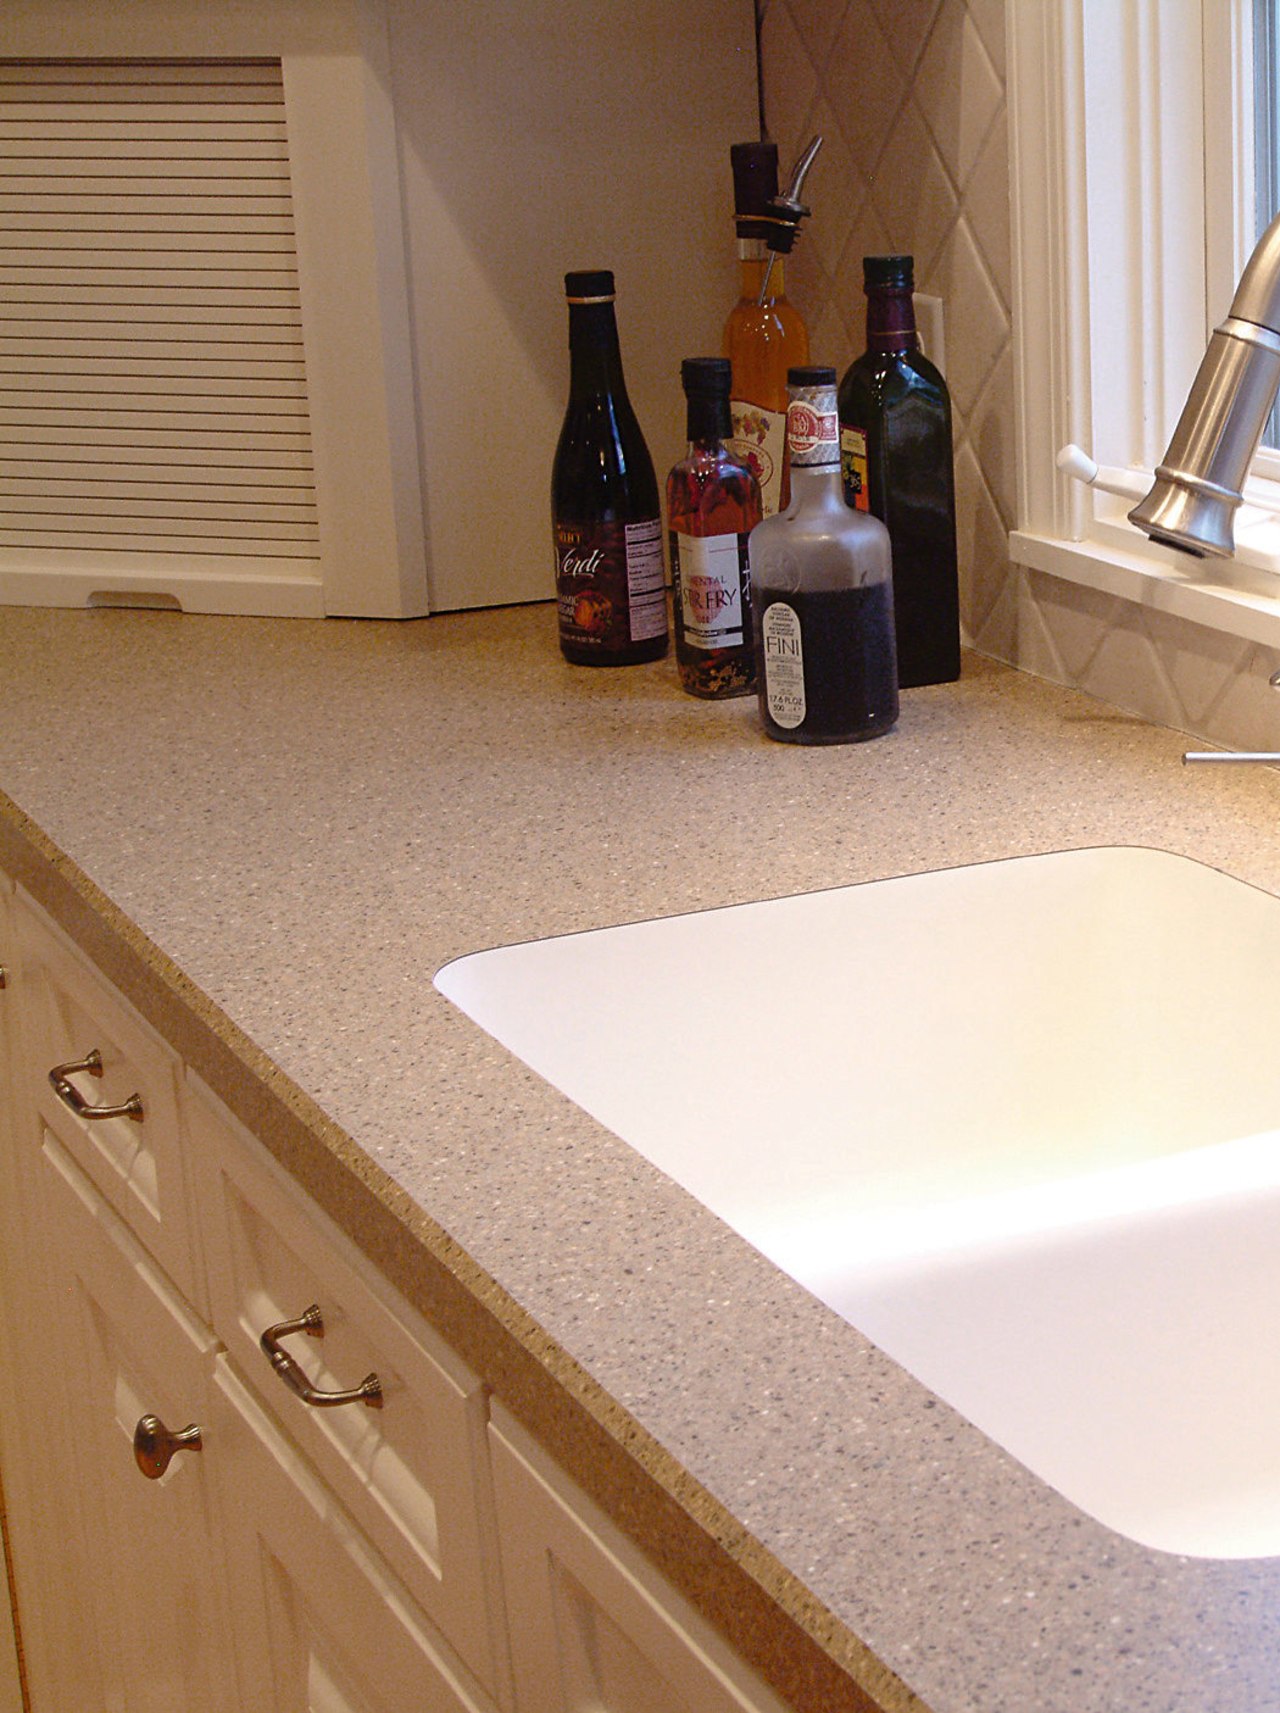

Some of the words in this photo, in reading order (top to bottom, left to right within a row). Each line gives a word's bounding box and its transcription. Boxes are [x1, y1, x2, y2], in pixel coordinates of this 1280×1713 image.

[555, 547, 605, 578] Verdi
[706, 588, 737, 609] FRY
[766, 635, 800, 656] FINI
